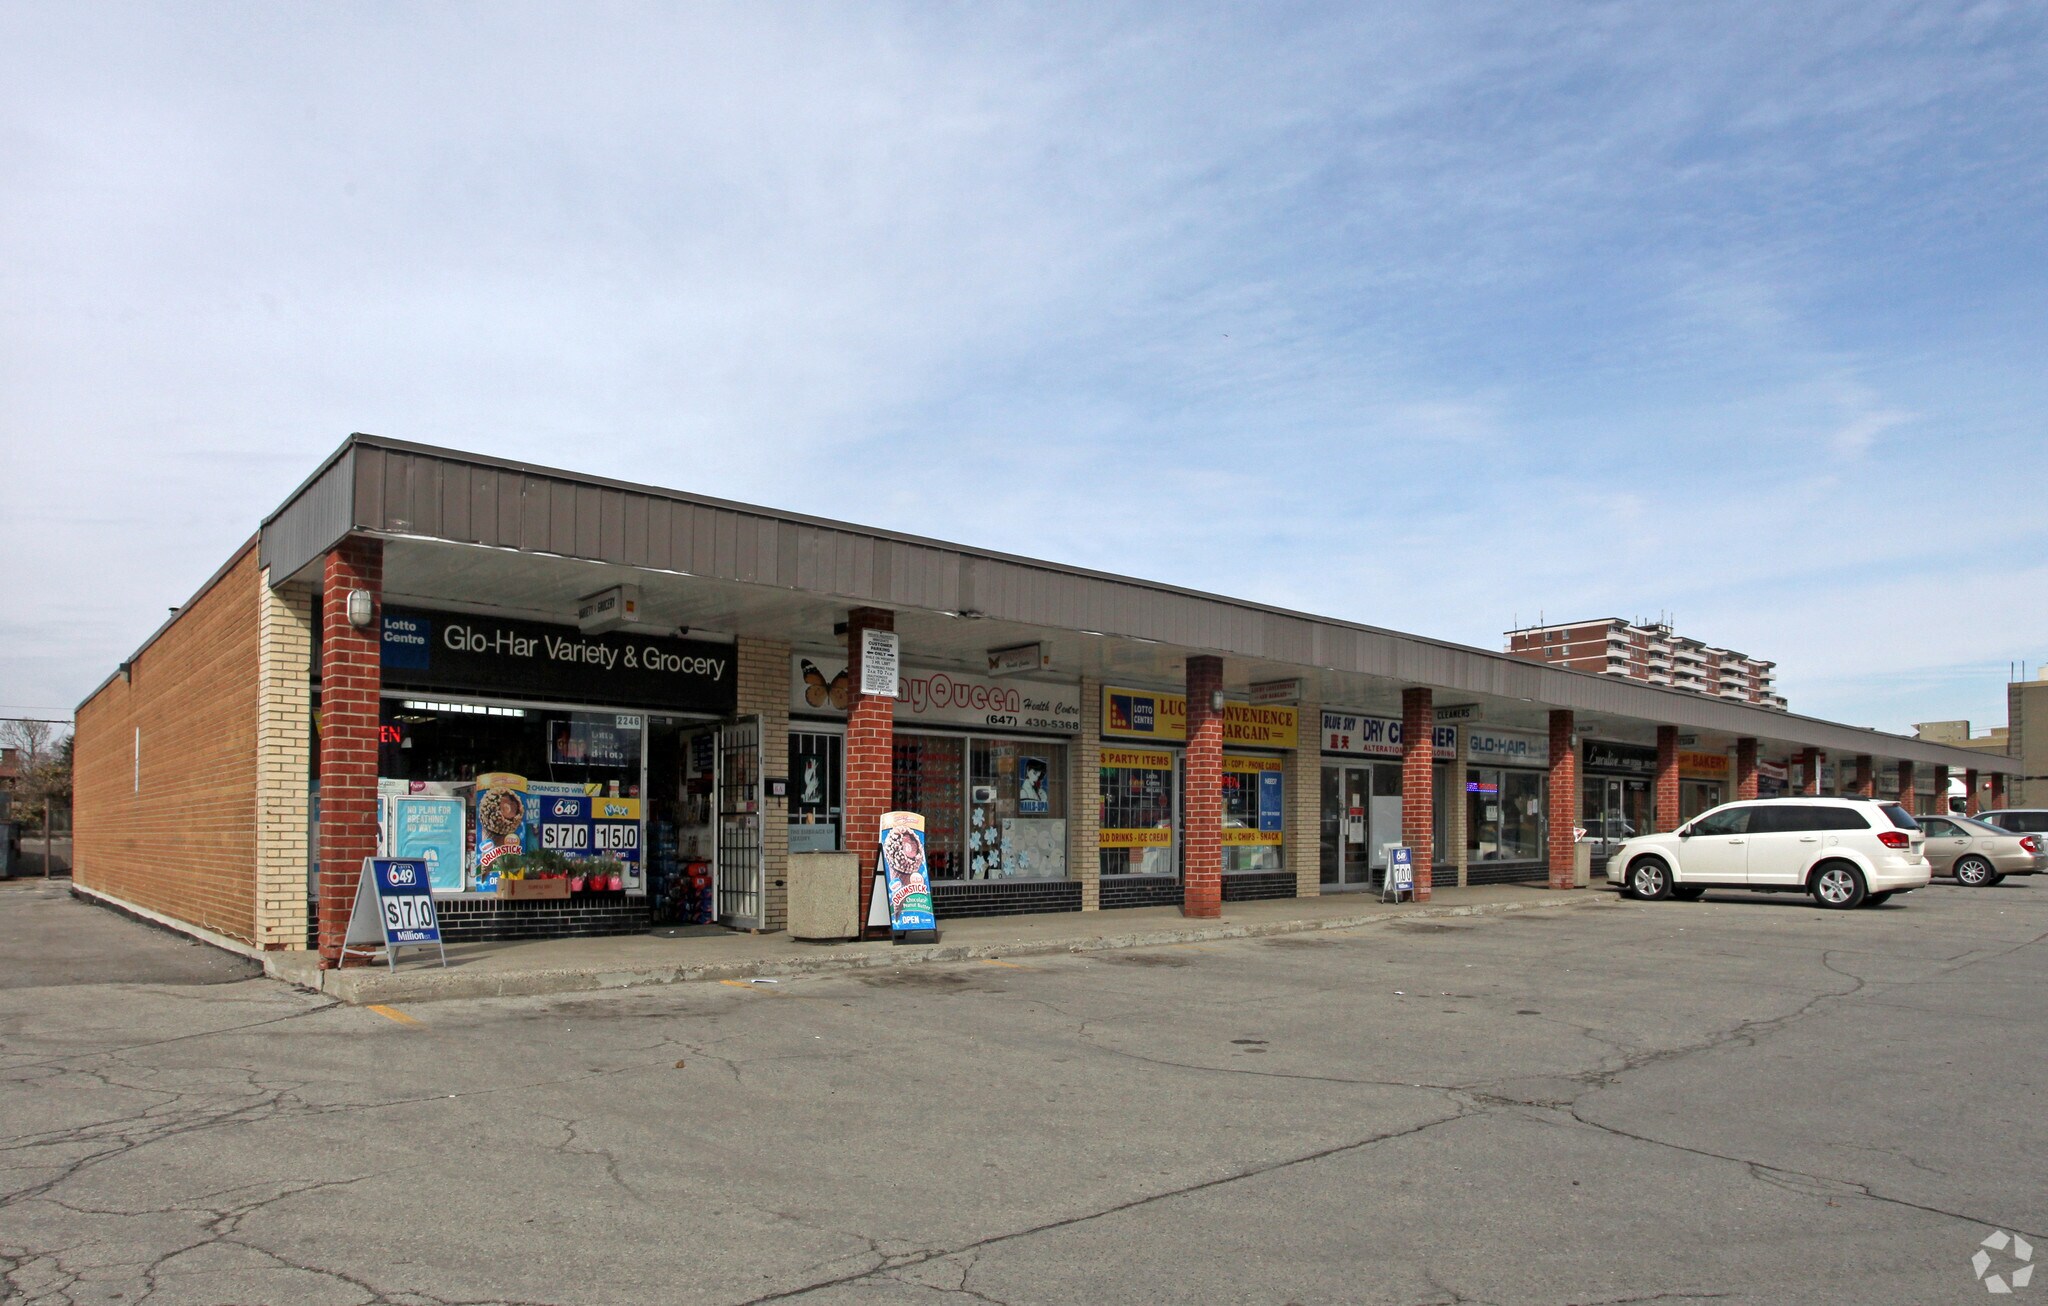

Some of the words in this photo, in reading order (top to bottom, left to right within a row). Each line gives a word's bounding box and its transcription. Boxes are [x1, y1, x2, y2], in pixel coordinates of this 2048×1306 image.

[597, 596, 616, 613] GROCERY
[384, 618, 417, 632] Lotto
[383, 631, 425, 645] Centre
[868, 640, 893, 648] CUSTOMER
[443, 624, 539, 658] Glo-Har
[544, 634, 619, 671] Variety
[623, 644, 639, 669] &
[642, 646, 726, 681] Grocery
[894, 673, 1020, 714] ayQueen
[1022, 698, 1050, 712] Health
[1054, 702, 1080, 715] Centre
[1133, 704, 1153, 715] LOTTO
[1159, 698, 1187, 717] LUC
[1222, 704, 1293, 727] NVENIENCE
[1436, 708, 1470, 720] CLEANERS
[616, 715, 640, 726] 2246
[985, 714, 1018, 728] (647)
[1025, 717, 1080, 731] 430-5368
[1133, 714, 1154, 726] CENTRE
[379, 725, 401, 743] EN
[1323, 714, 1341, 730] BLUE
[1343, 717, 1356, 731] SKY
[1363, 718, 1385, 743] DRY
[1470, 735, 1527, 755] GLO-HAIR
[1108, 752, 1140, 765] PARTY
[1142, 755, 1170, 766] ITEMS
[1231, 760, 1245, 769] COPY
[1248, 761, 1265, 770] PHONE
[1692, 754, 1728, 769] BAKERY
[531, 785, 561, 793] CHANCES
[561, 786, 569, 794] TO
[569, 786, 585, 795] WIN
[407, 805, 417, 815] NO
[418, 806, 436, 815] PLAN
[438, 806, 451, 815] FOR
[407, 814, 448, 824] BREATHING?
[407, 823, 417, 833] NO
[1099, 832, 1110, 842] OLD
[1111, 832, 1134, 843] DRINKS
[1138, 832, 1148, 842] ICE
[1149, 832, 1169, 843] CREAM
[1221, 832, 1233, 841] ILK
[1238, 832, 1256, 842] CHIPS
[1260, 832, 1280, 841] SNACK
[481, 845, 523, 866] DRUMSTICK
[892, 884, 928, 905] DRUMSTICK
[905, 896, 928, 904] Chocolate
[902, 915, 920, 925] OPEN
[397, 930, 424, 942] Million
